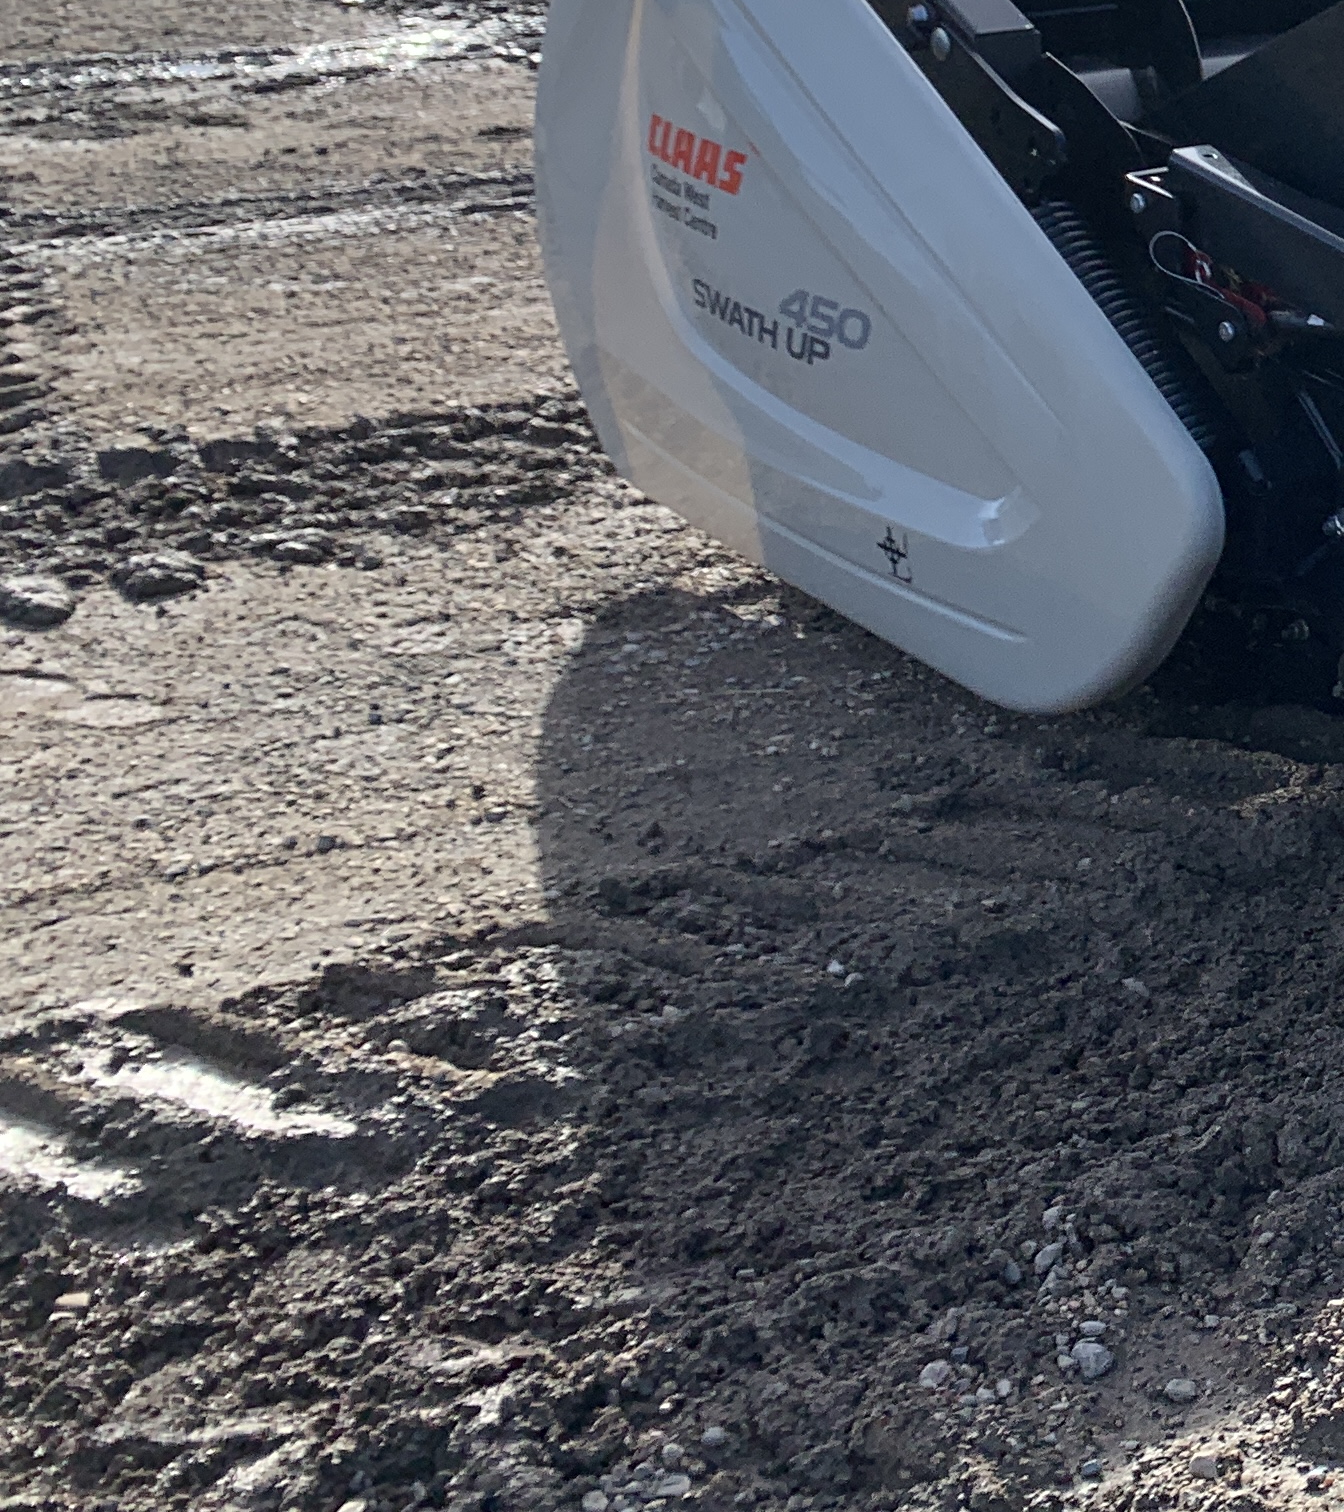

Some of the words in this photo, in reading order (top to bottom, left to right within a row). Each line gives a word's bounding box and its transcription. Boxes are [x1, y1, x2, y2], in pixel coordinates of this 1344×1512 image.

[648, 112, 748, 196] CLAAS
[692, 278, 779, 350] SWATH
[786, 327, 831, 365] UP
[779, 288, 872, 350] 450
